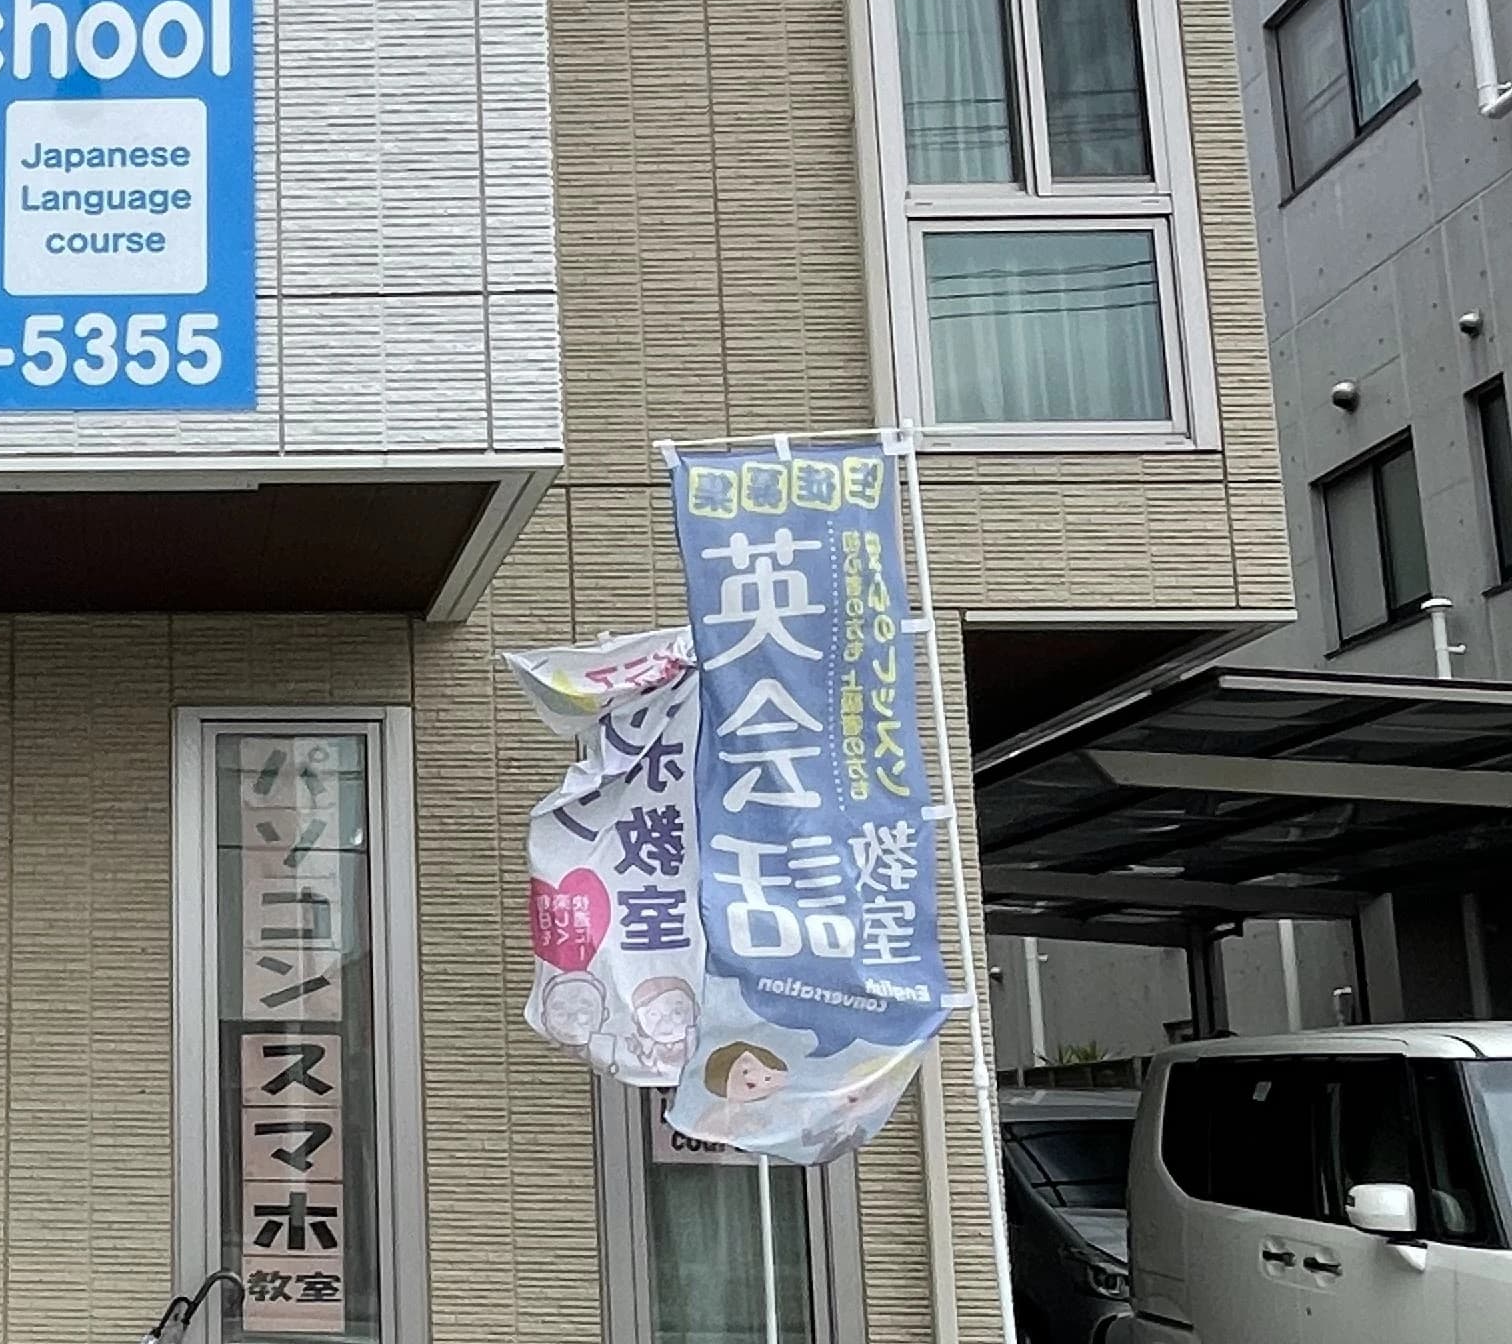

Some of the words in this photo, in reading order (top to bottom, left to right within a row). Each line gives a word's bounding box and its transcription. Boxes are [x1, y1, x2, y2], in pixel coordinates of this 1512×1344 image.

[20, 141, 191, 174] Japanese
[21, 184, 191, 219] Language
[45, 229, 166, 256] course
[247, 1268, 342, 1304] 教室
